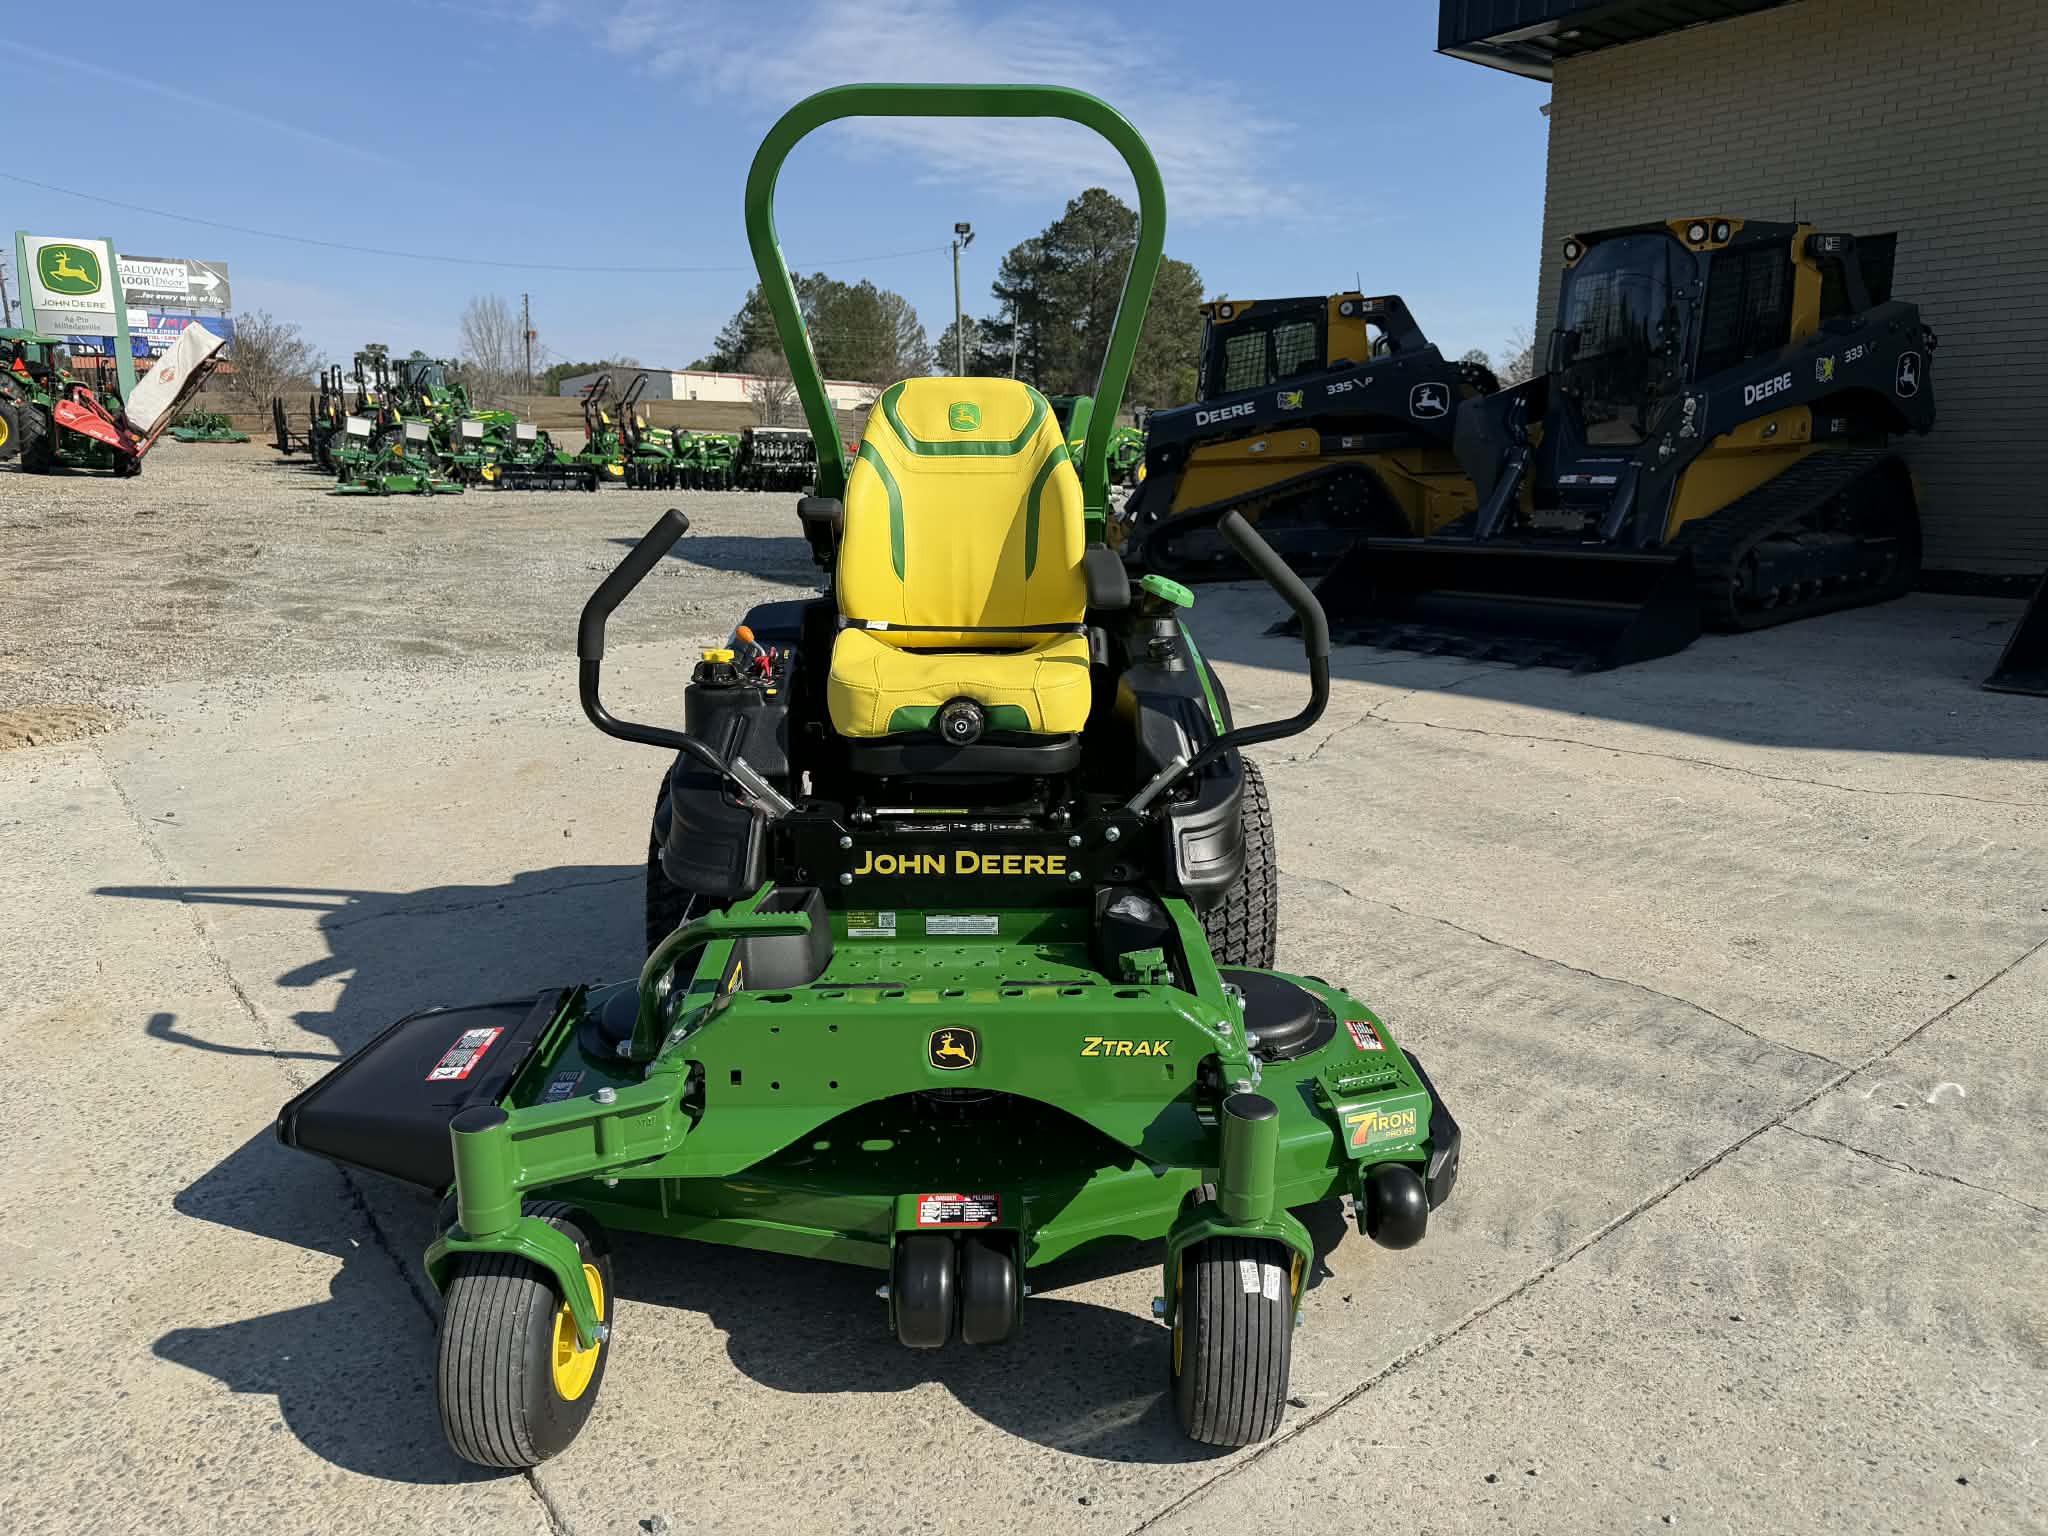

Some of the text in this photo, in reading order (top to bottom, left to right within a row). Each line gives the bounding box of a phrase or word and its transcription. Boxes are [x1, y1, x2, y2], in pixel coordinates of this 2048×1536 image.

[115, 263, 185, 277] GALLOWAY'S
[41, 296, 107, 309] JOHN DEERE
[155, 294, 178, 302] every
[199, 295, 208, 303] of
[1743, 371, 1793, 407] DEERE
[1194, 400, 1257, 427] DEERE
[855, 850, 1066, 875] JOHN DEERE
[1080, 1036, 1171, 1057] ZTRAK
